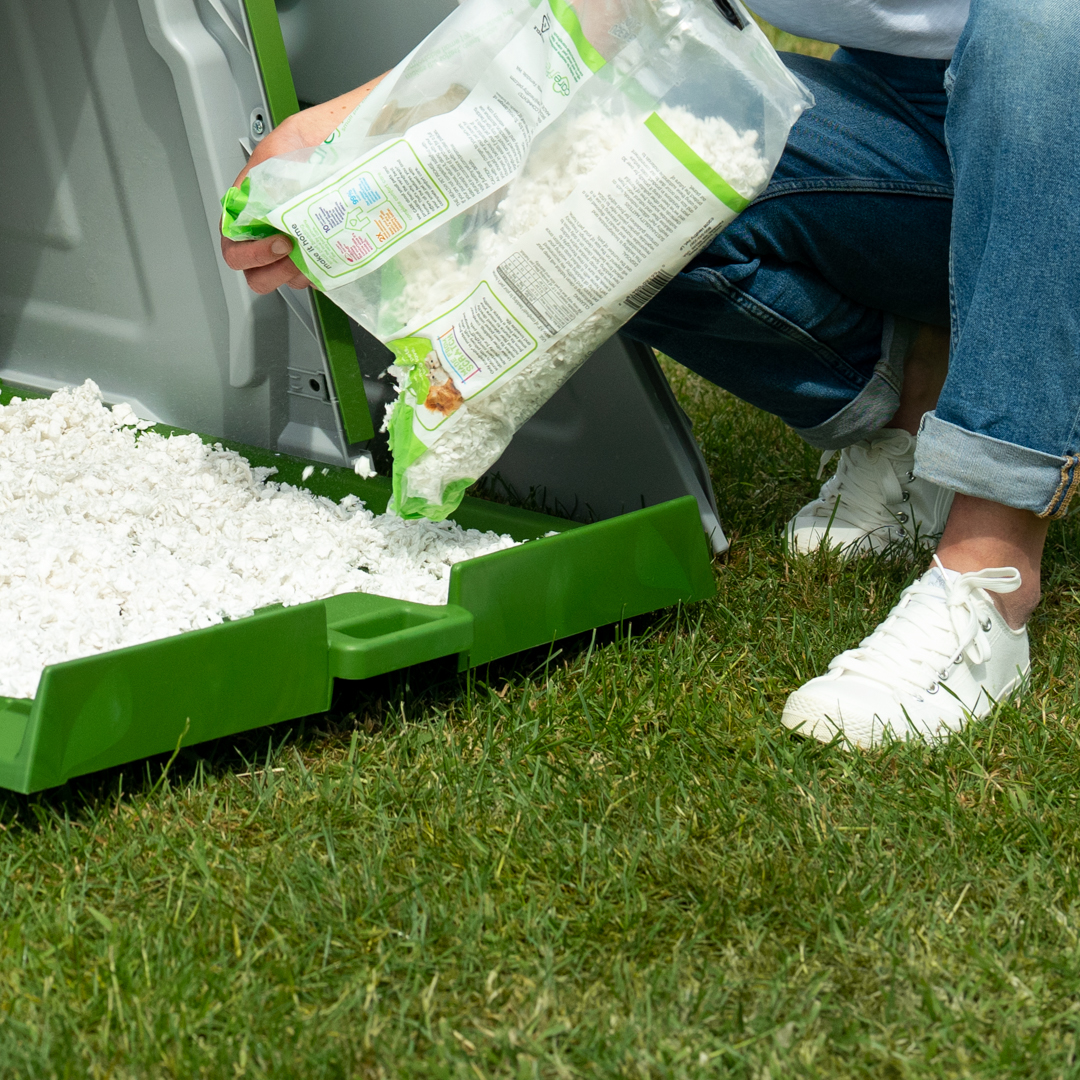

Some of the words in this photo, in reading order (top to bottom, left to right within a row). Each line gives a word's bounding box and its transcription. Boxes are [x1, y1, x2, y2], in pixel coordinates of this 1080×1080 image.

[377, 172, 386, 183] care
[387, 173, 396, 184] pets
[388, 167, 397, 177] best
[396, 175, 404, 185] very
[393, 183, 402, 193] small
[407, 184, 415, 193] why
[419, 175, 432, 190] comfort
[346, 189, 359, 205] 99%
[384, 182, 400, 201] comfort
[400, 192, 409, 203] about
[405, 191, 414, 200] them
[429, 189, 444, 207] complete
[396, 200, 414, 221] complete
[407, 203, 416, 213] CARE
[411, 199, 427, 218] providing
[624, 201, 640, 217] MATTERS
[290, 222, 308, 246] home
[322, 223, 331, 233] 10
[639, 216, 664, 241] SUSTAINABILITY
[375, 231, 385, 242] 2X
[306, 245, 314, 253] it
[311, 251, 331, 271] make
[621, 250, 638, 267] DISPOSAL
[572, 293, 589, 310] CLEANING
[441, 337, 452, 356] FROM
[446, 333, 474, 372] SCRATCH
[450, 357, 467, 376] MADE
